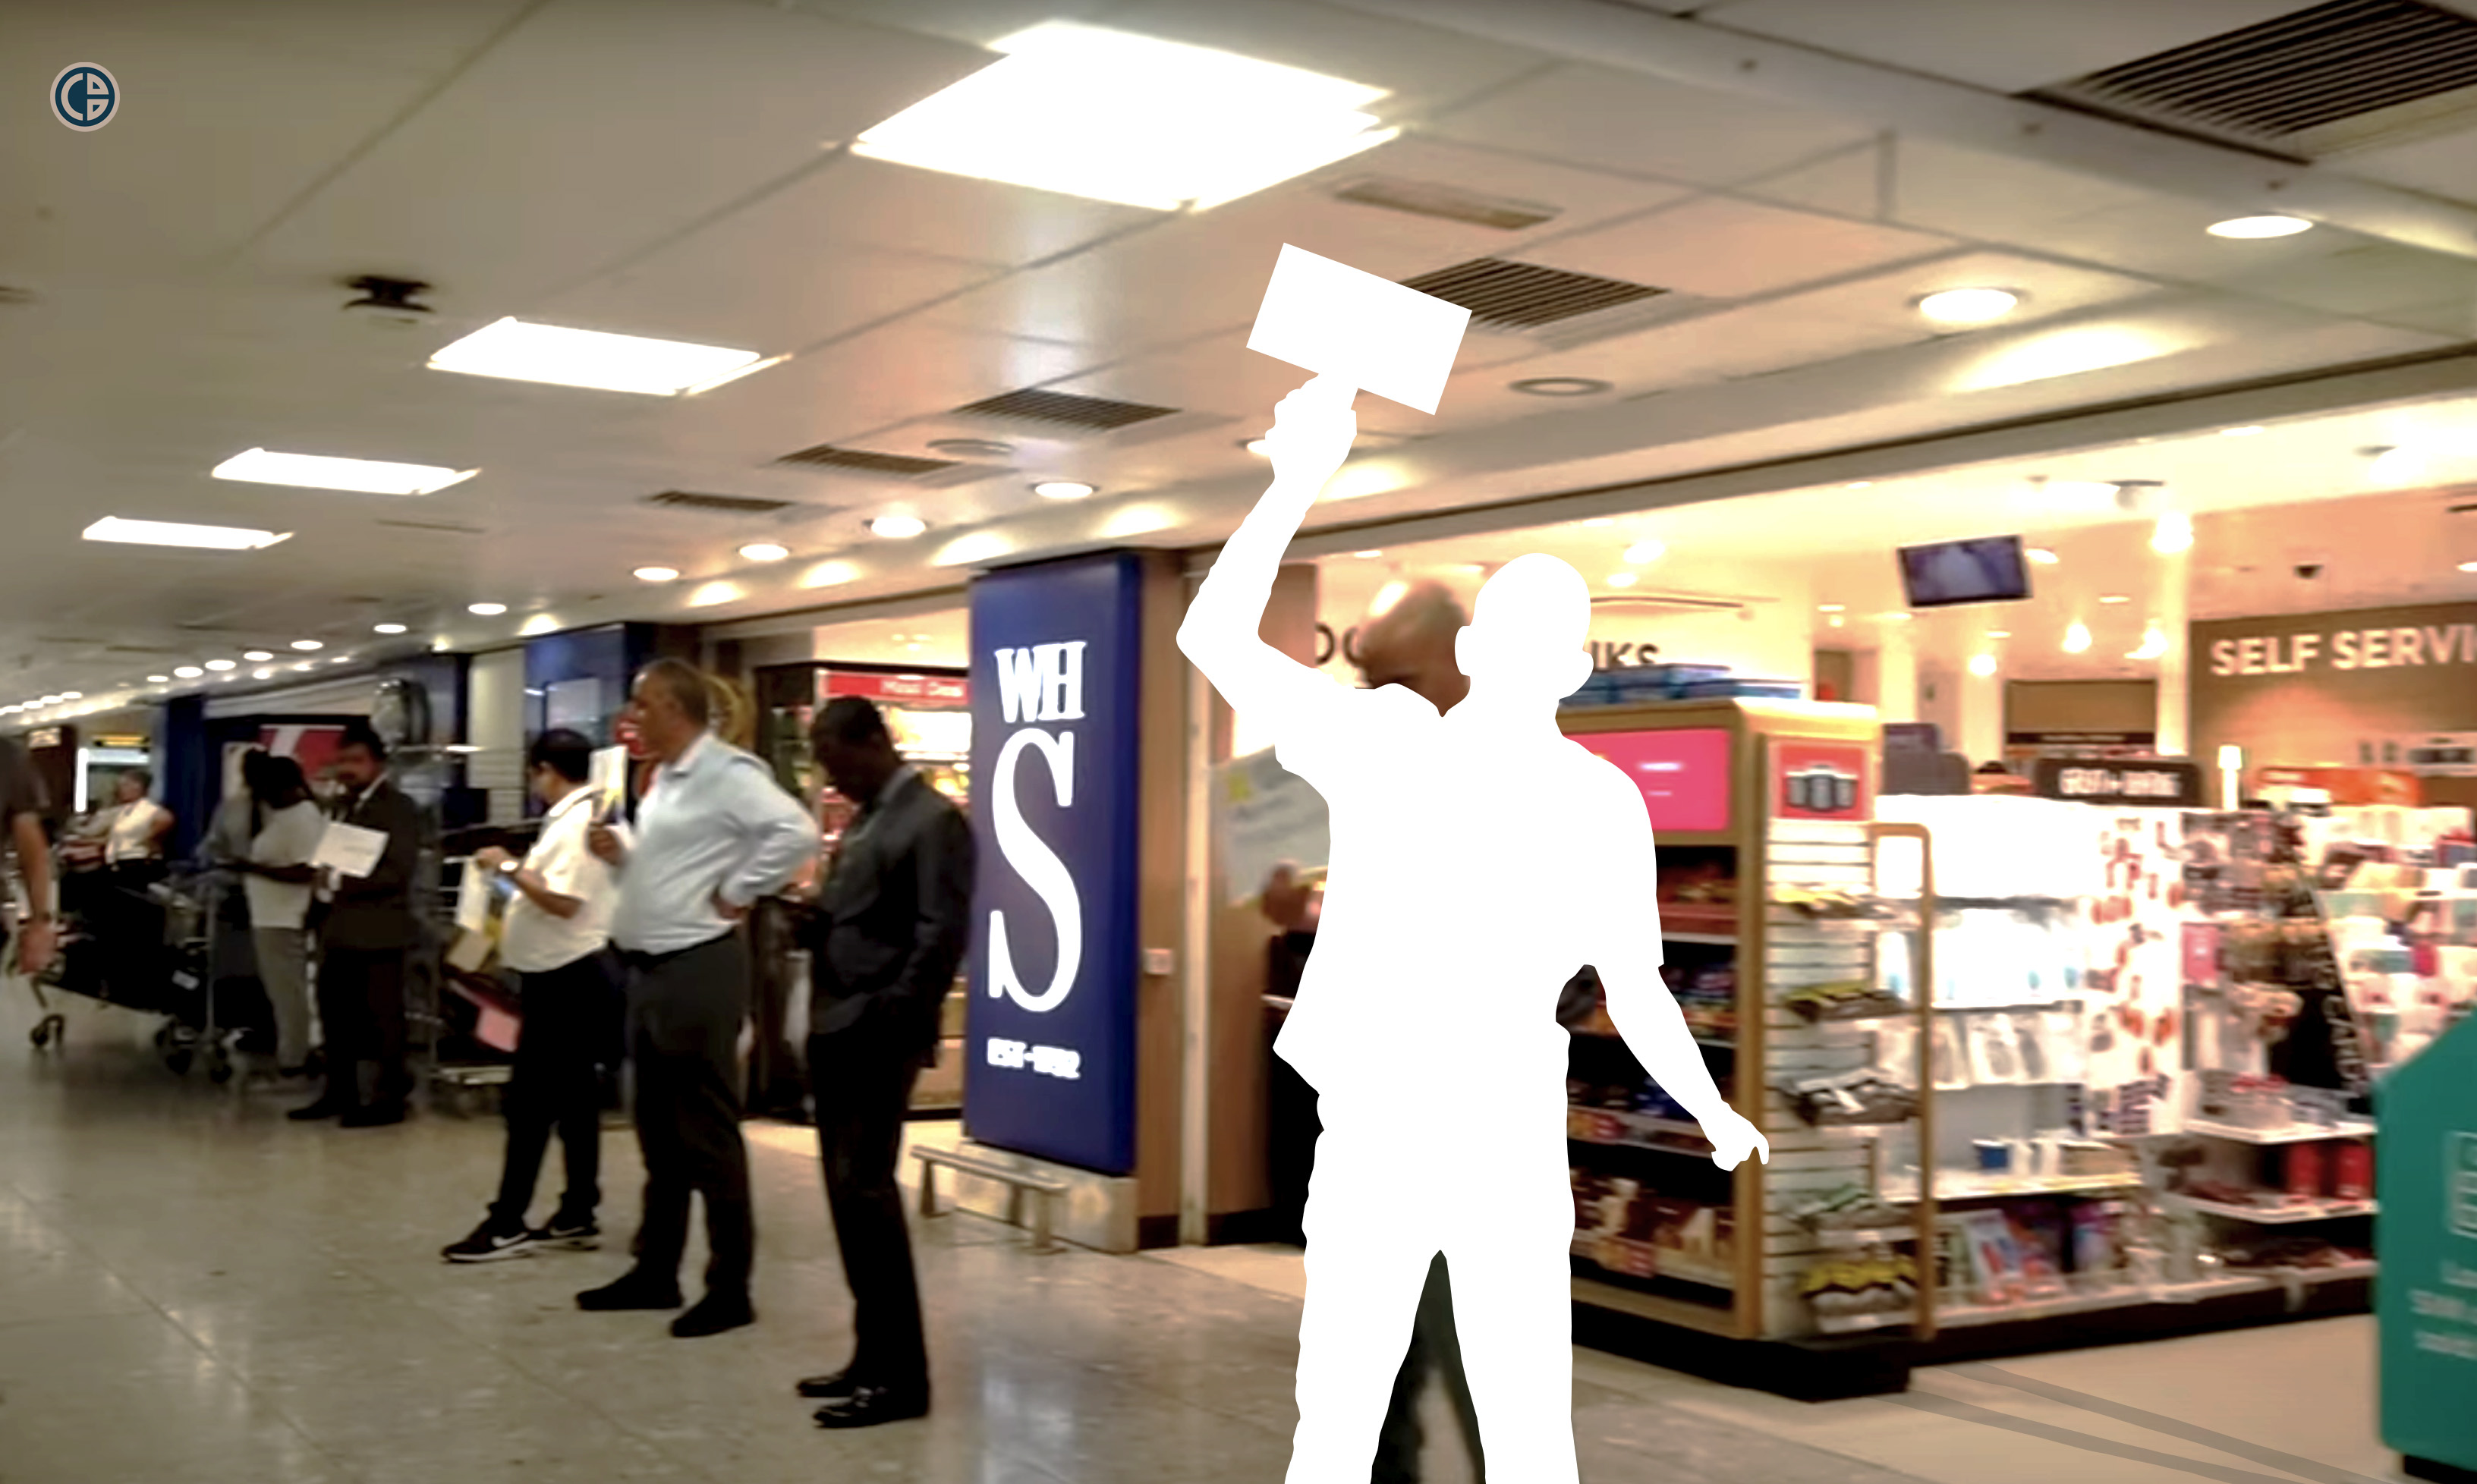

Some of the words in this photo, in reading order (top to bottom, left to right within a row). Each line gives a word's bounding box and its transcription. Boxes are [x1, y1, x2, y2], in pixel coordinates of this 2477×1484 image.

[994, 640, 1087, 723] WH
[2210, 632, 2321, 675] SELF
[989, 728, 1081, 1012] S
